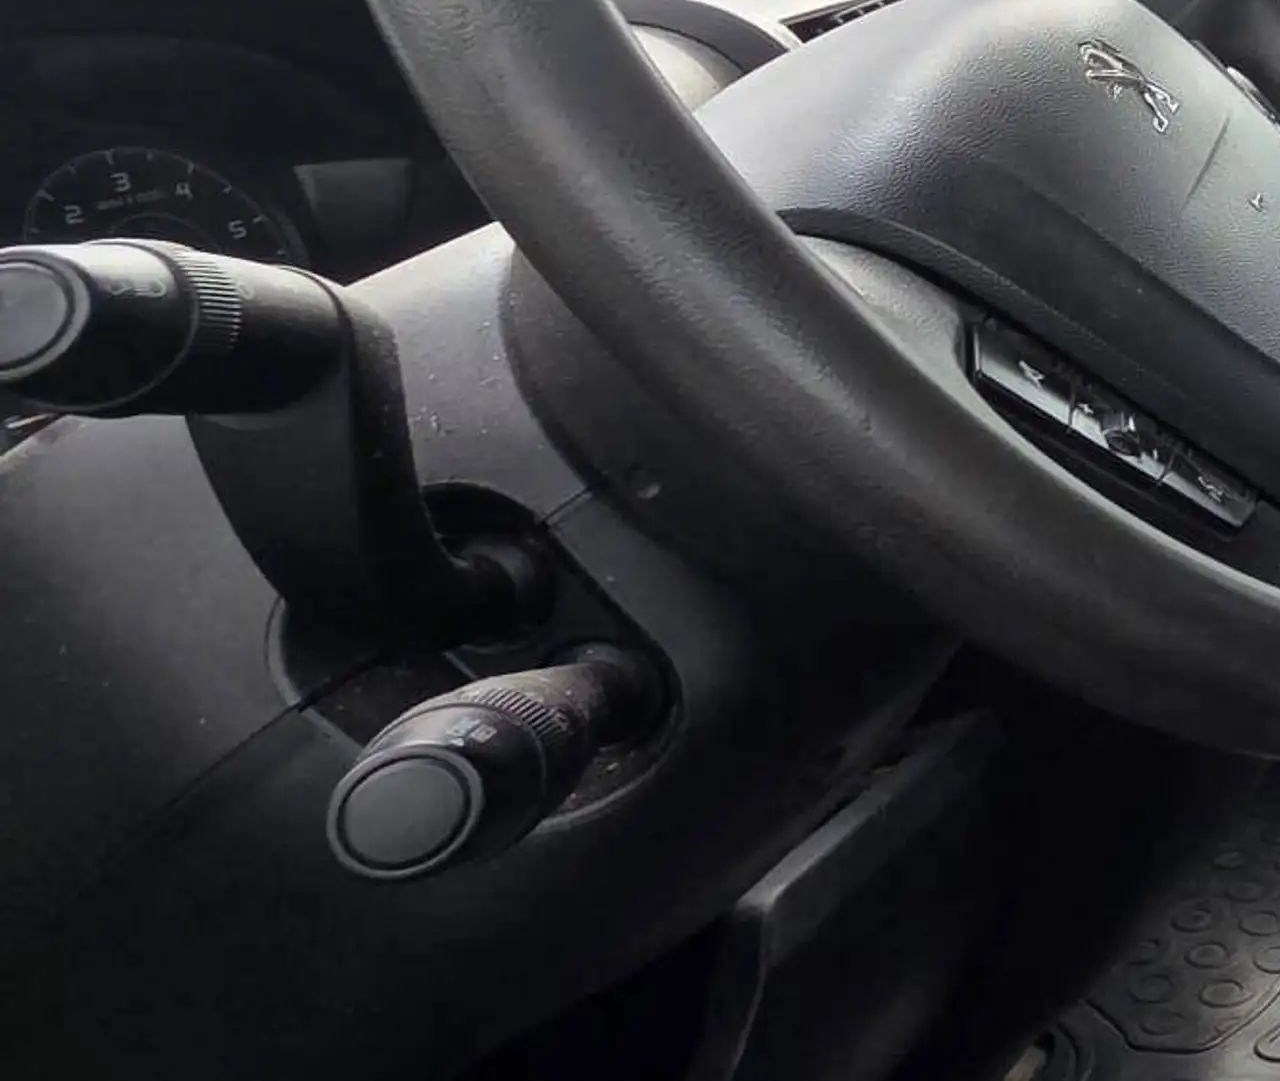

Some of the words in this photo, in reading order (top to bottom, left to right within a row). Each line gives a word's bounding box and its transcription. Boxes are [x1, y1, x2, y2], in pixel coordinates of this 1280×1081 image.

[110, 172, 132, 193] 3
[175, 183, 194, 200] 4
[64, 205, 85, 225] 2
[228, 220, 247, 240] 5
